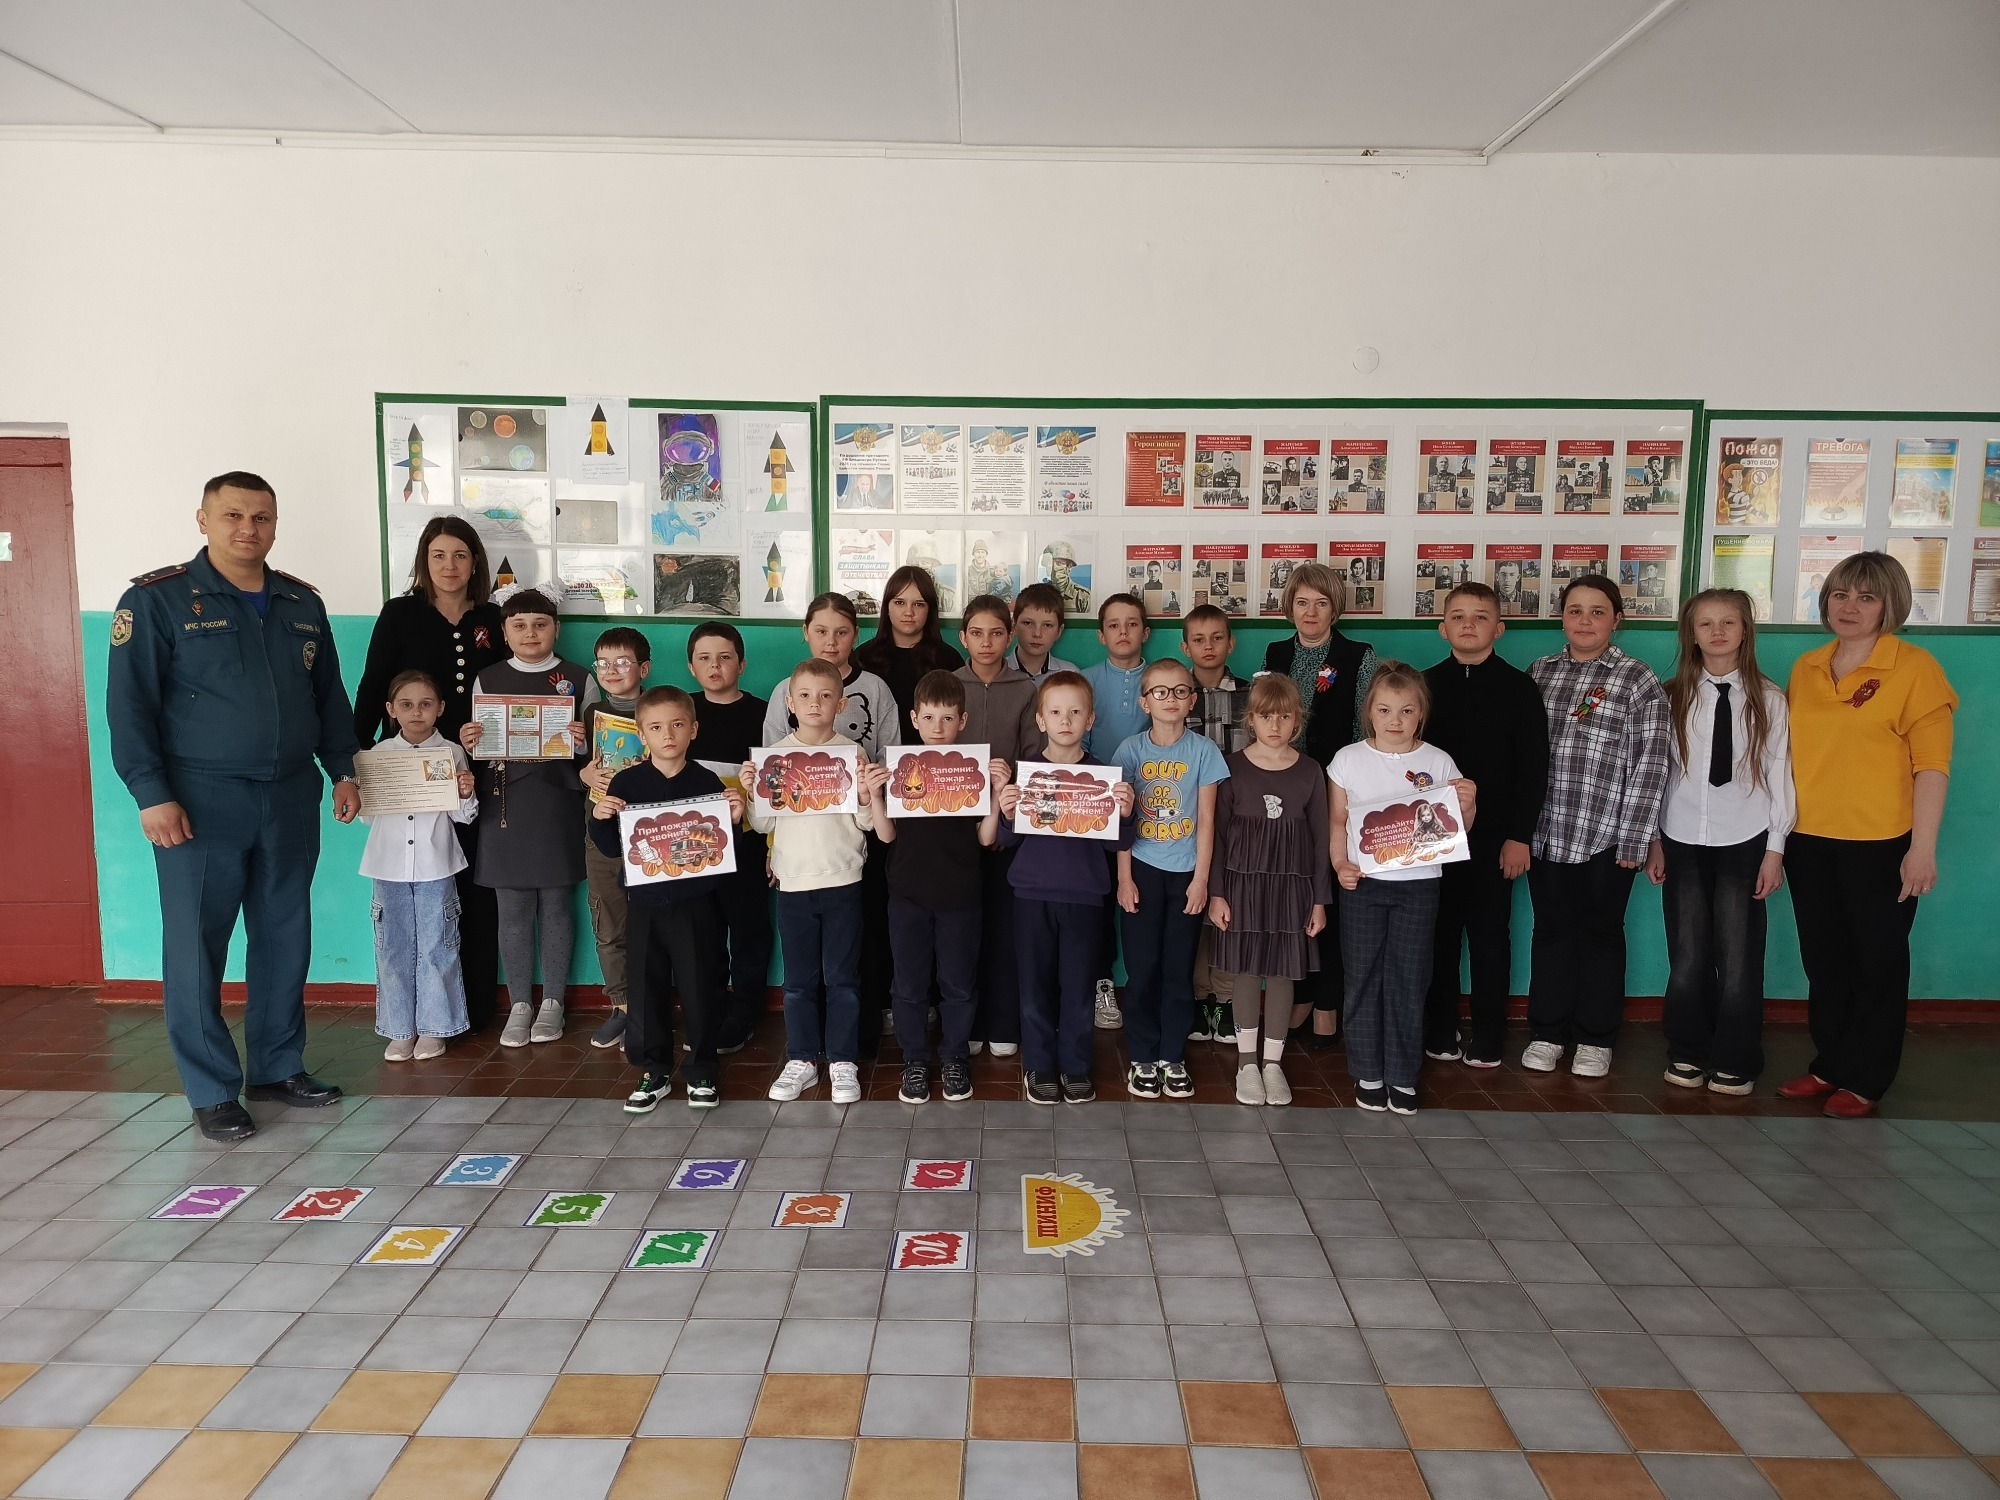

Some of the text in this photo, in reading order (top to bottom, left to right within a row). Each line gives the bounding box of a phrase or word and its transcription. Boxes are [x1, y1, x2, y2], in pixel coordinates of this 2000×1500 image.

[1134, 440, 1155, 448] Герои
[1725, 441, 1777, 457] Пожар
[1816, 442, 1864, 451] ТРЕВОГА
[184, 619, 228, 630] МЧС РОССИИ
[804, 765, 840, 773] Спички
[930, 766, 974, 775] Запомни:
[1140, 761, 1188, 782] OUT
[934, 776, 965, 784] пожар
[801, 786, 846, 796] игрушки!
[926, 782, 980, 793] НЕ шутки!
[1153, 786, 1171, 798] OF
[1056, 800, 1112, 808] осторожен
[1147, 797, 1177, 808] THIS
[1071, 807, 1105, 815] огнем!
[637, 819, 699, 836] При пожаре
[1364, 818, 1415, 835] Соблюдайте
[1374, 826, 1407, 838] правила
[649, 830, 691, 842] звонить
[1371, 831, 1412, 844] пожарной
[460, 1163, 493, 1177] 3
[693, 1168, 725, 1180] 6
[924, 1168, 957, 1180] 9
[188, 1196, 222, 1207] 1
[302, 1196, 343, 1210] 2
[551, 1201, 590, 1216] 5
[794, 1203, 831, 1218] 8
[1034, 1186, 1059, 1239] ФИНИШ
[392, 1236, 426, 1252] 4
[655, 1241, 692, 1255] 7
[911, 1239, 949, 1260] 10
